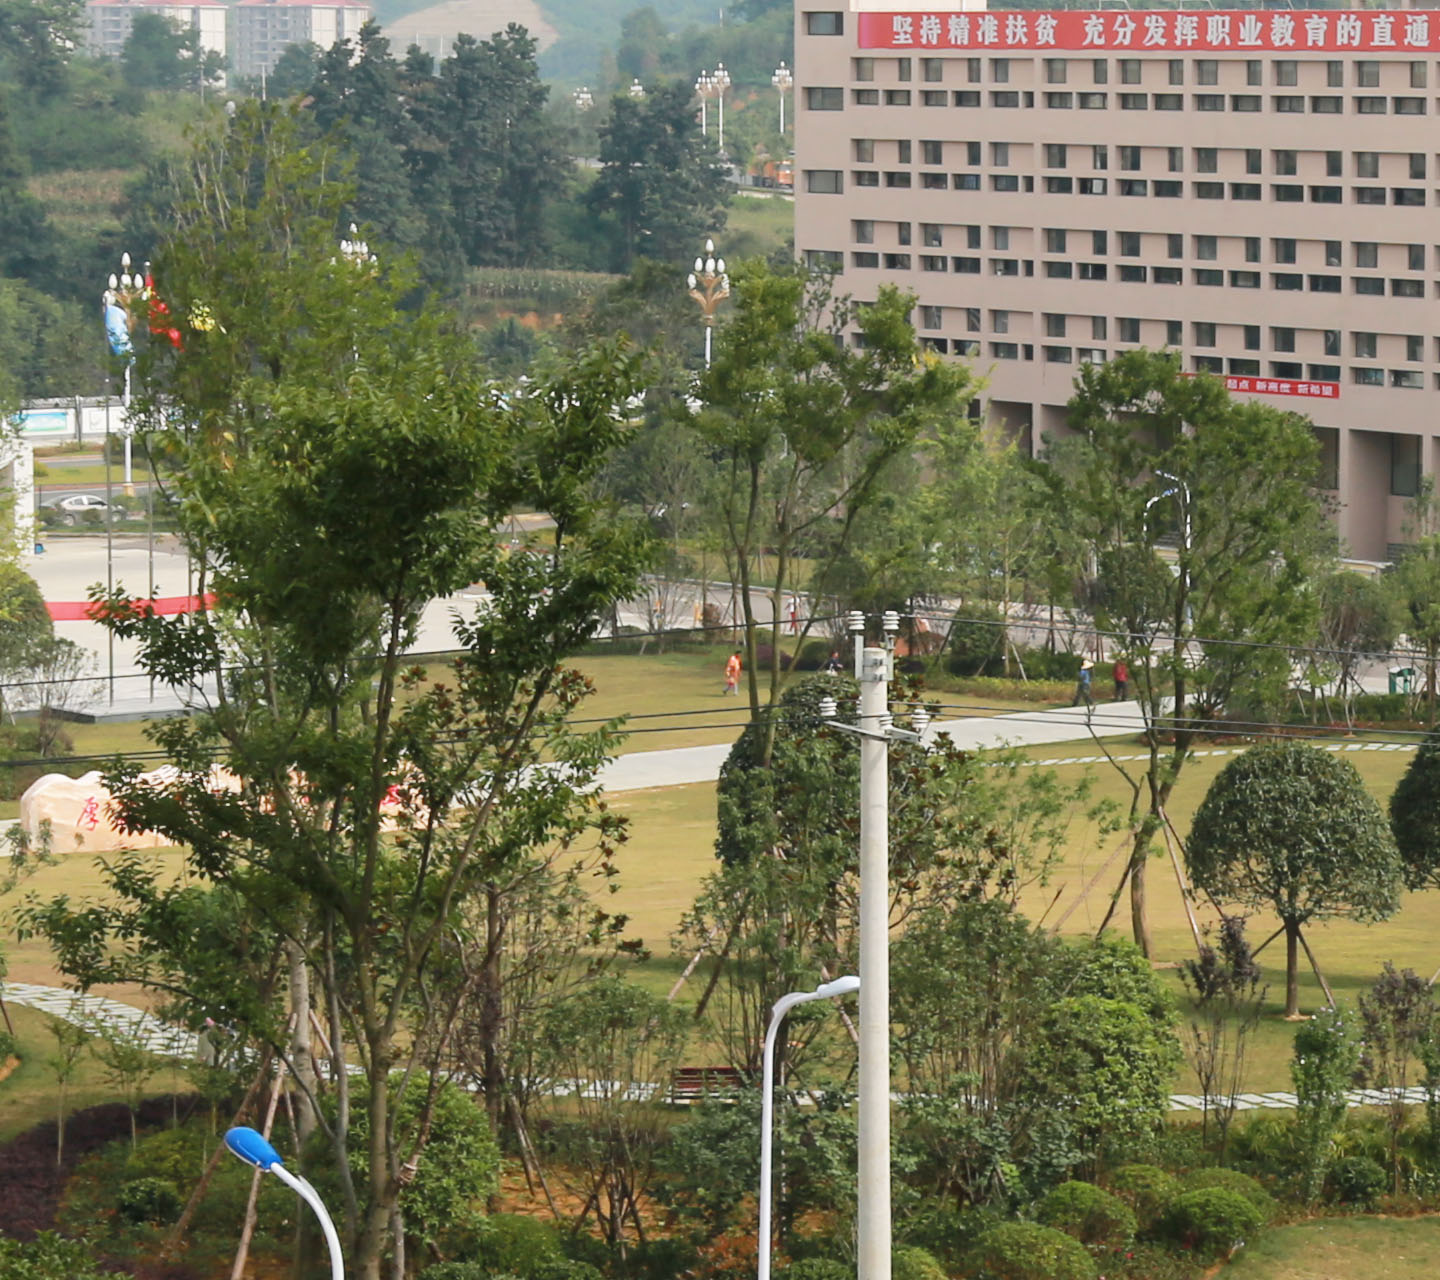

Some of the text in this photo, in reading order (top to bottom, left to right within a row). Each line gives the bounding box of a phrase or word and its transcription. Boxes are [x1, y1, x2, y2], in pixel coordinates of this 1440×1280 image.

[892, 14, 1059, 47] 坚持精准扶贫
